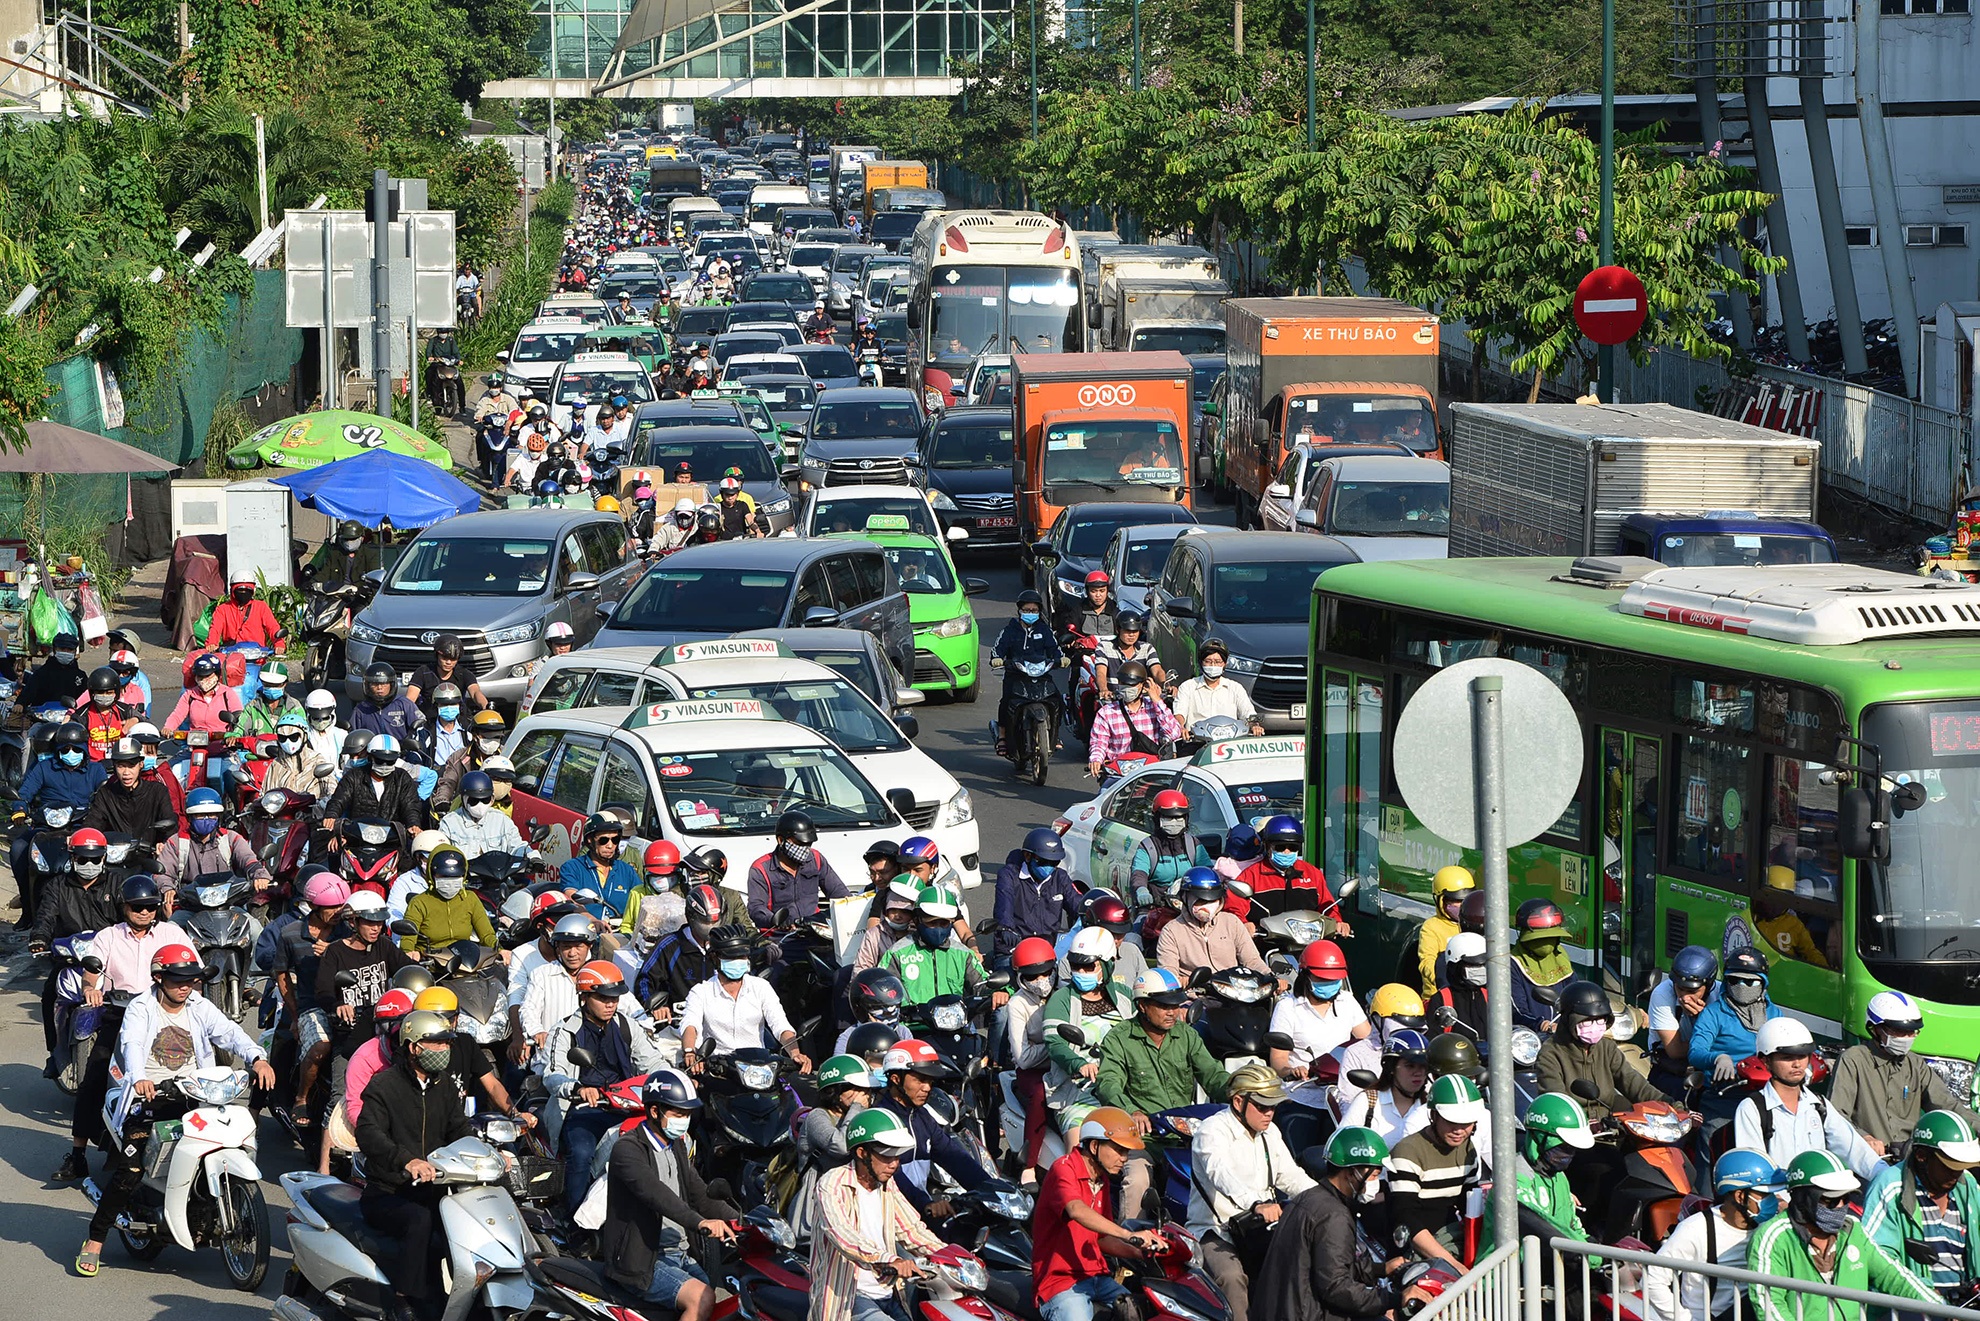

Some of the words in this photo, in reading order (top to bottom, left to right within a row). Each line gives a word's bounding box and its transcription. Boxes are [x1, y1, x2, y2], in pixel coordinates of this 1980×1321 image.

[1303, 328, 1322, 340] XE
[1328, 326, 1360, 340] THƯ
[1363, 325, 1397, 340] BÁO
[1080, 387, 1133, 403] TNT
[342, 424, 387, 448] C2
[1690, 612, 1716, 626] DENSO
[1293, 706, 1304, 717] 51
[1784, 710, 1820, 729] SAMCO
[1236, 742, 1306, 755] VINASUNTA
[1238, 796, 1268, 804] 9109
[1688, 781, 1707, 820] 103
[900, 952, 924, 964] Grab
[820, 1067, 840, 1081] Grab
[1528, 1111, 1549, 1125] Grab
[848, 1126, 866, 1140] Grab
[1915, 1128, 1933, 1140] Grab
[1350, 1146, 1376, 1158] Grab
